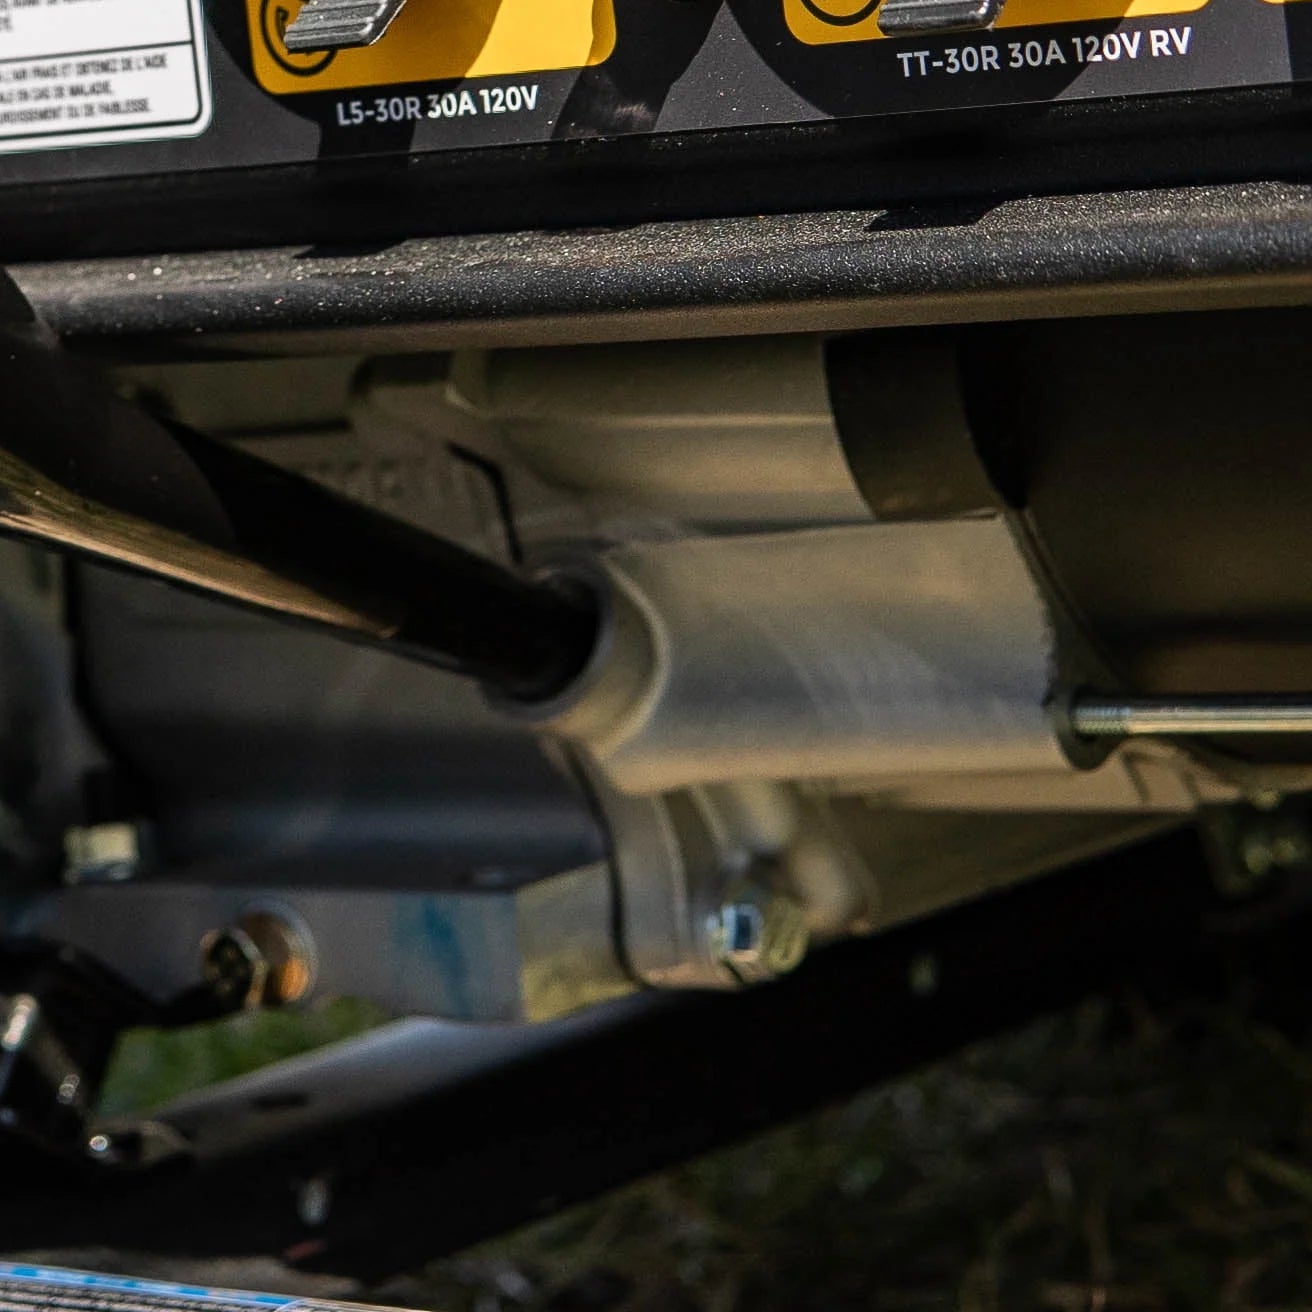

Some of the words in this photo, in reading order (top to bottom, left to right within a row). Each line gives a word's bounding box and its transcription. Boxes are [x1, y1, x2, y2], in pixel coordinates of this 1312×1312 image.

[896, 45, 1001, 78] TT-30R
[1007, 39, 1066, 68] 30A
[1071, 31, 1142, 65] 120V
[1149, 26, 1192, 57] RV
[337, 96, 422, 126] L5-30R
[427, 90, 477, 119] 30A
[479, 85, 538, 114] 120V
